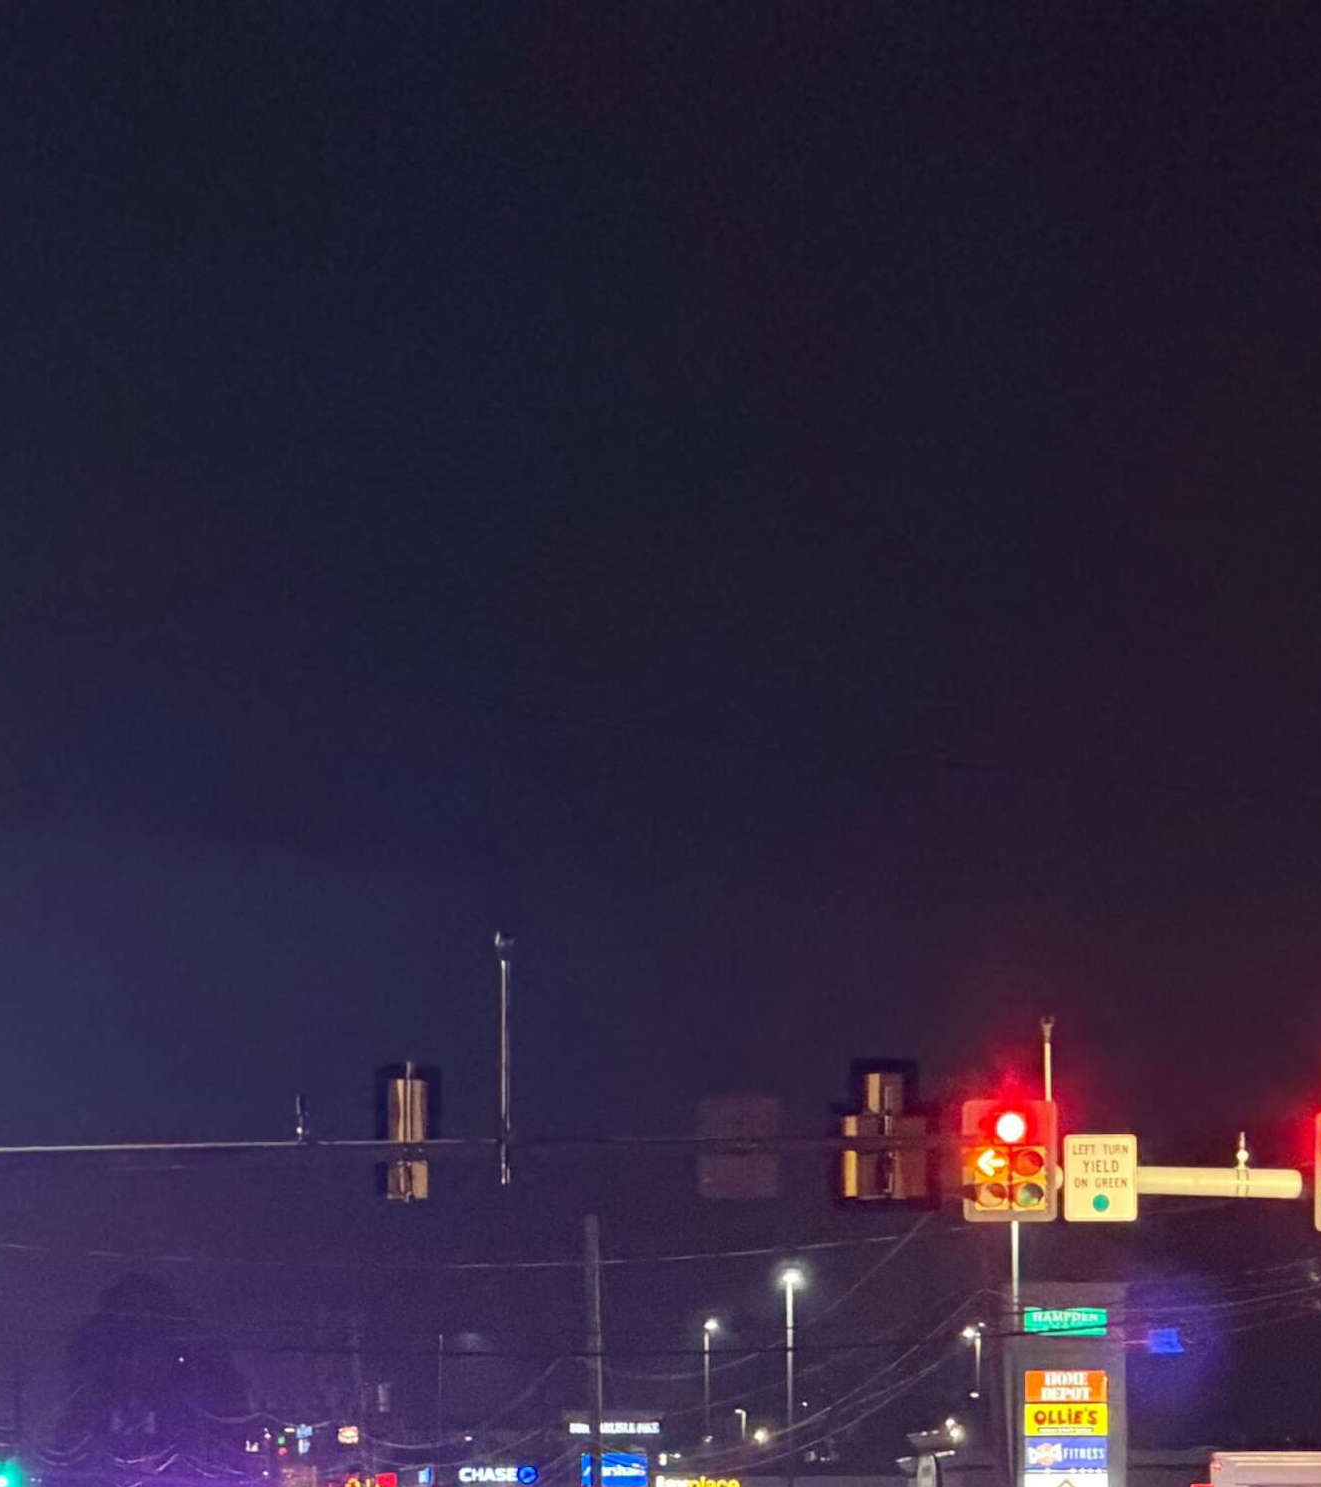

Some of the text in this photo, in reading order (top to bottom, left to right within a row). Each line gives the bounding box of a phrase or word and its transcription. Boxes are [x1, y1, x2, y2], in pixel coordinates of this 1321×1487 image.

[1072, 1144, 1128, 1155] LEFT TURN
[1083, 1160, 1119, 1173] YIELD
[1074, 1178, 1127, 1188] ON GREEN
[1044, 1371, 1088, 1386] HOME
[1041, 1387, 1090, 1401] DEPOT
[1063, 1448, 1105, 1460] FITNESS
[459, 1467, 518, 1482] CHASE
